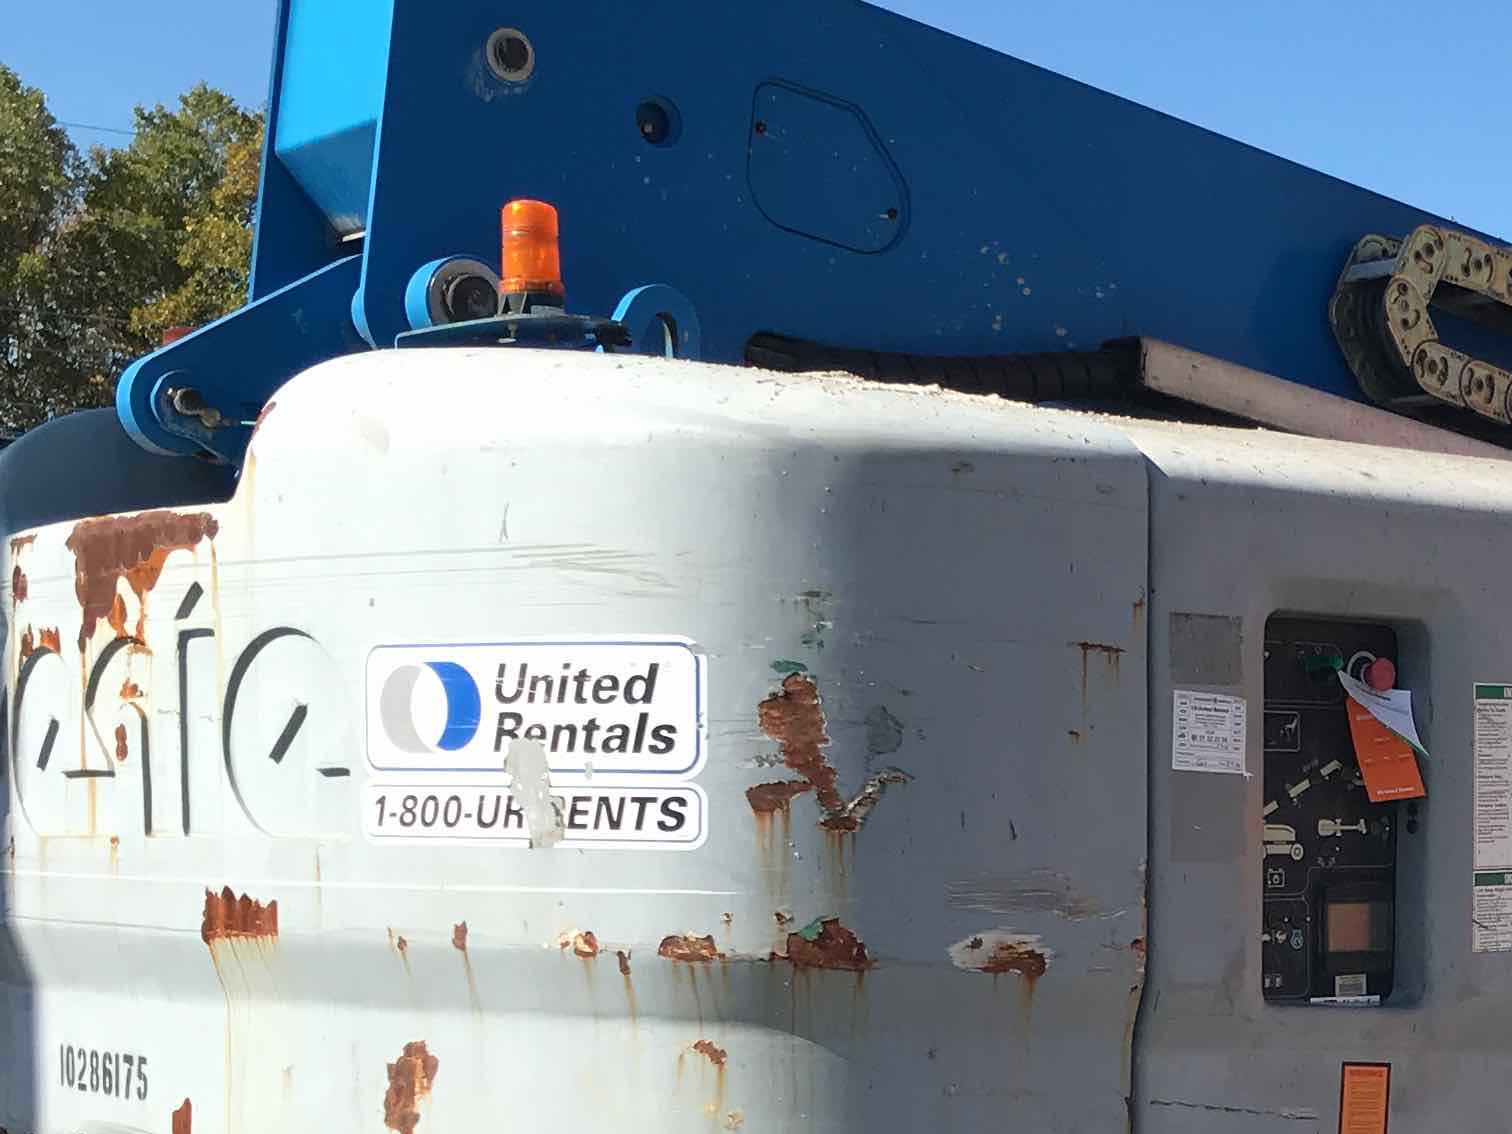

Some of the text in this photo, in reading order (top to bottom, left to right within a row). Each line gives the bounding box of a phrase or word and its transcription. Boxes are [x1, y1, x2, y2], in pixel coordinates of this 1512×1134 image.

[494, 662, 660, 705] United
[493, 712, 678, 754] Rentals
[375, 794, 688, 832] 1-800-URENTS
[60, 1043, 148, 1102] 10286175
